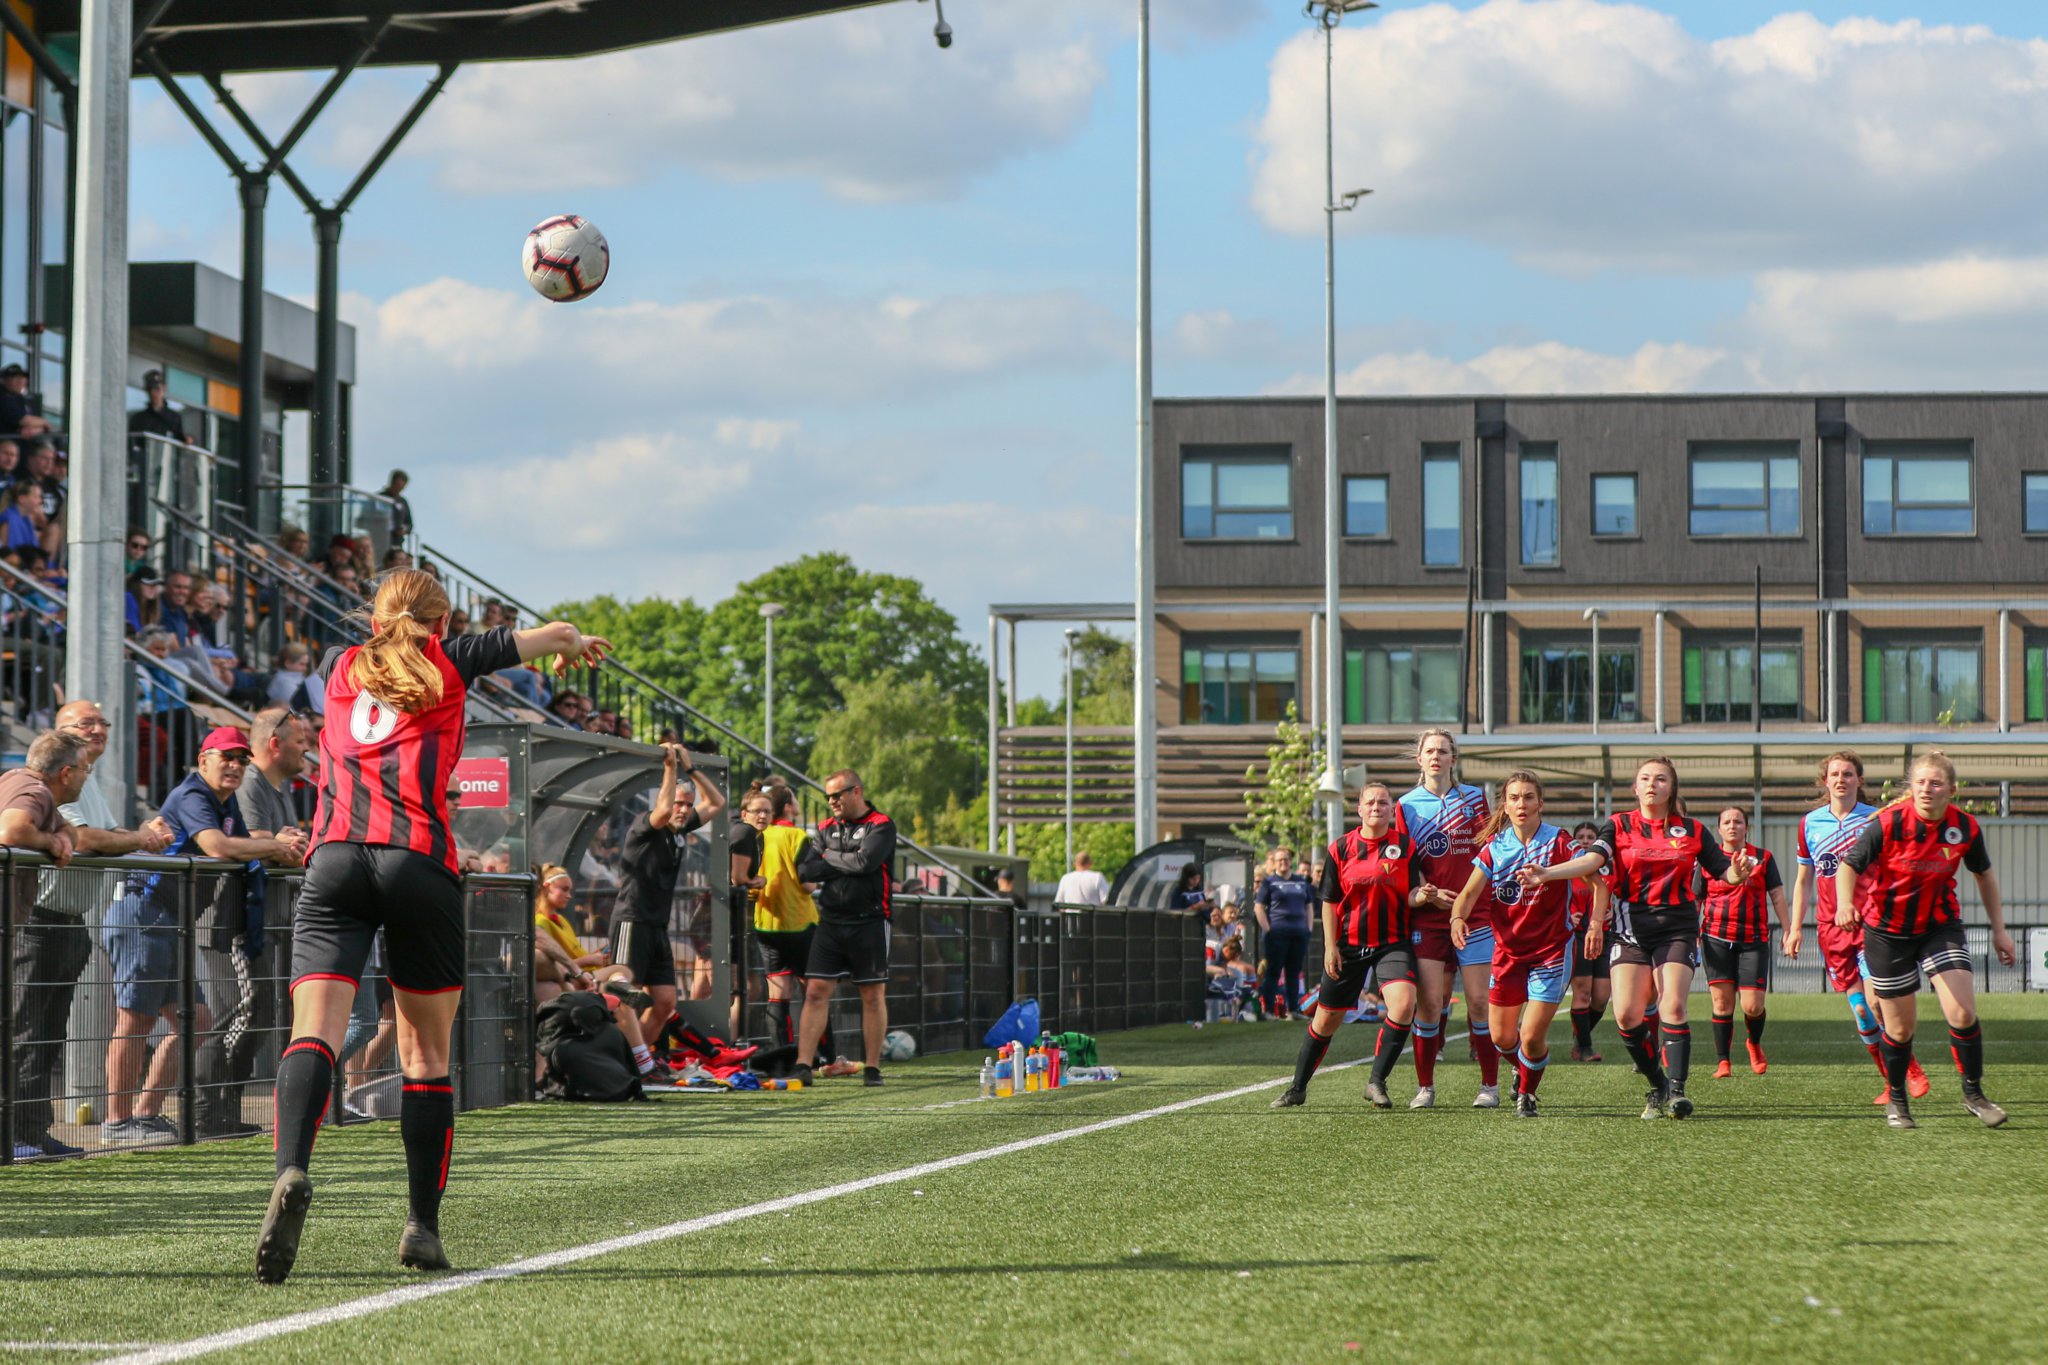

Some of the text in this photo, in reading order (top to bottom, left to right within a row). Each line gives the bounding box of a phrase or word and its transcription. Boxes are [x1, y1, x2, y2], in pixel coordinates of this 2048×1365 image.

[457, 779, 499, 793] ome
[1426, 837, 1448, 851] RDS
[1818, 858, 1838, 870] RDS
[1498, 886, 1520, 899] RDS
